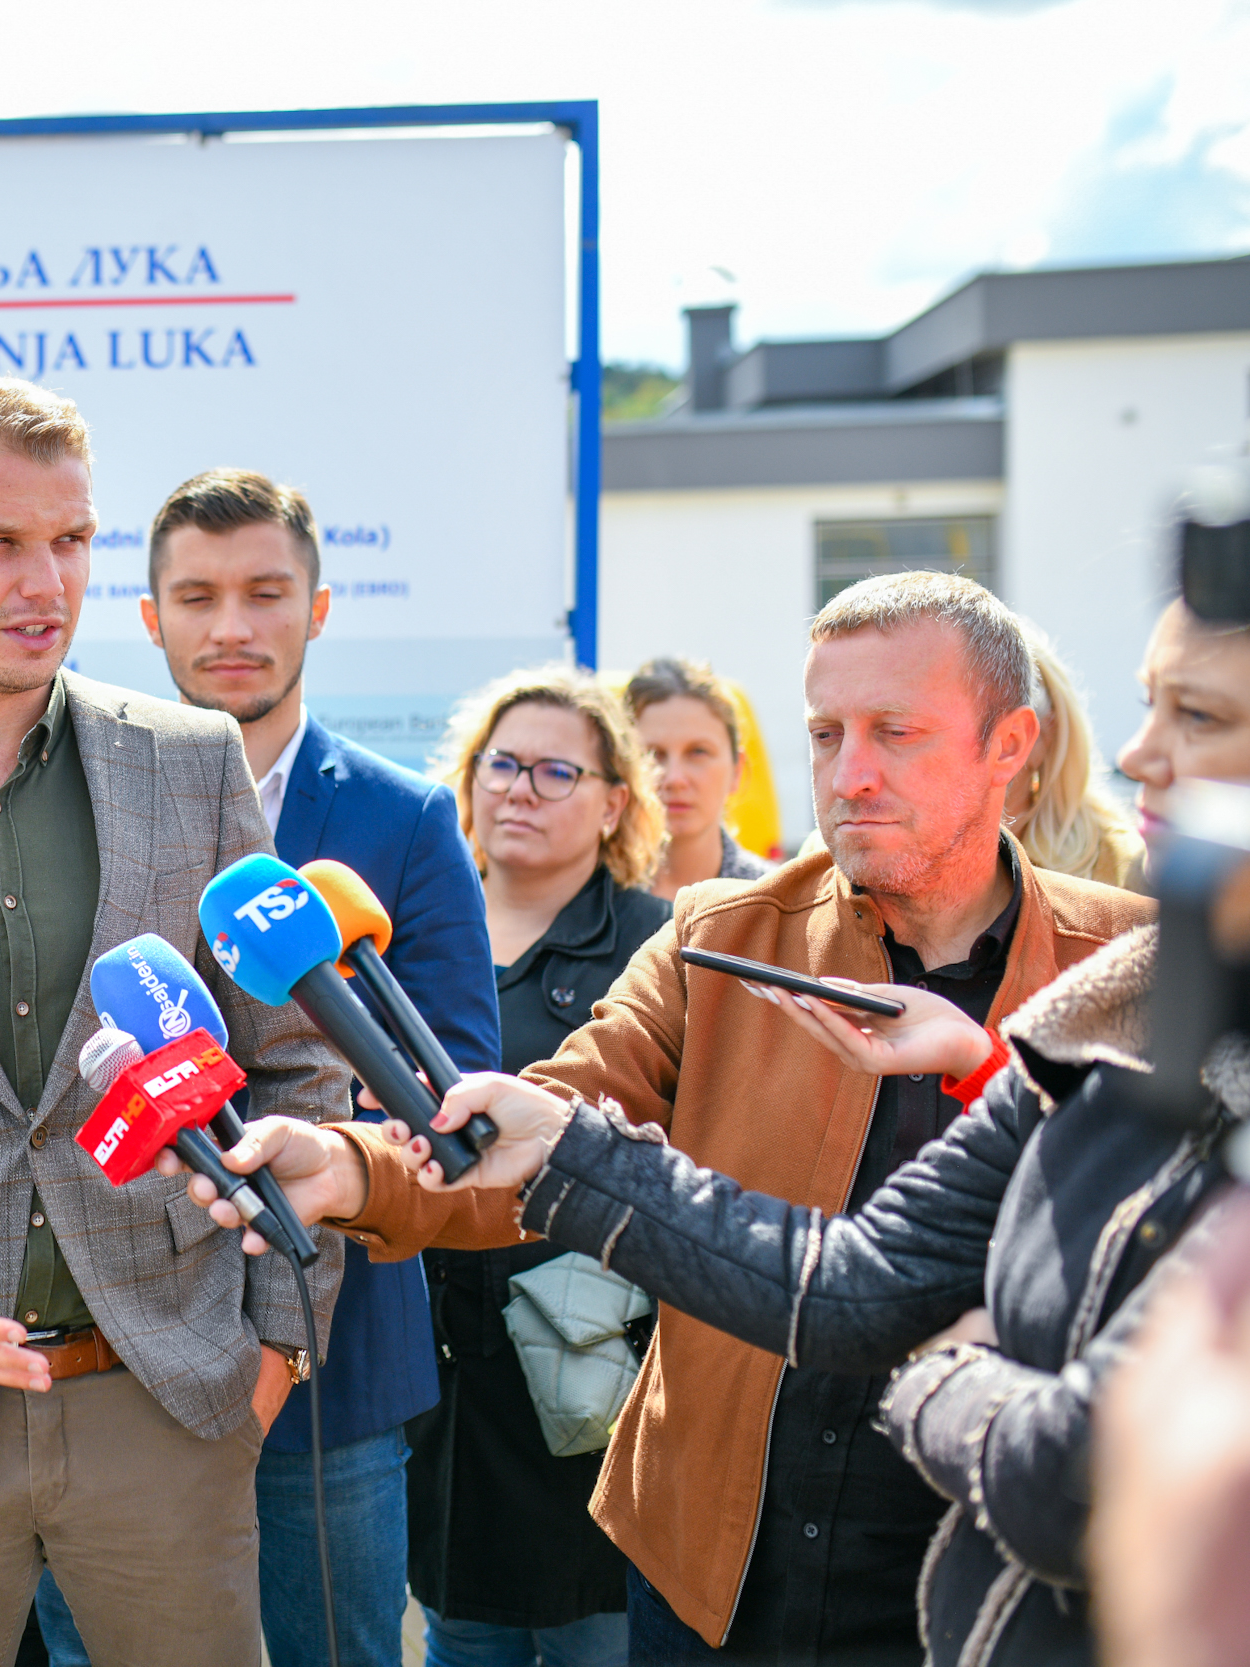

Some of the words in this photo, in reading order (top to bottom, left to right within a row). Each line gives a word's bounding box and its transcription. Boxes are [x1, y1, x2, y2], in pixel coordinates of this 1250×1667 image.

[68, 244, 222, 287] ЛУКА
[107, 326, 259, 371] LUKA
[91, 528, 144, 549] odni
[322, 524, 392, 552] Kola)
